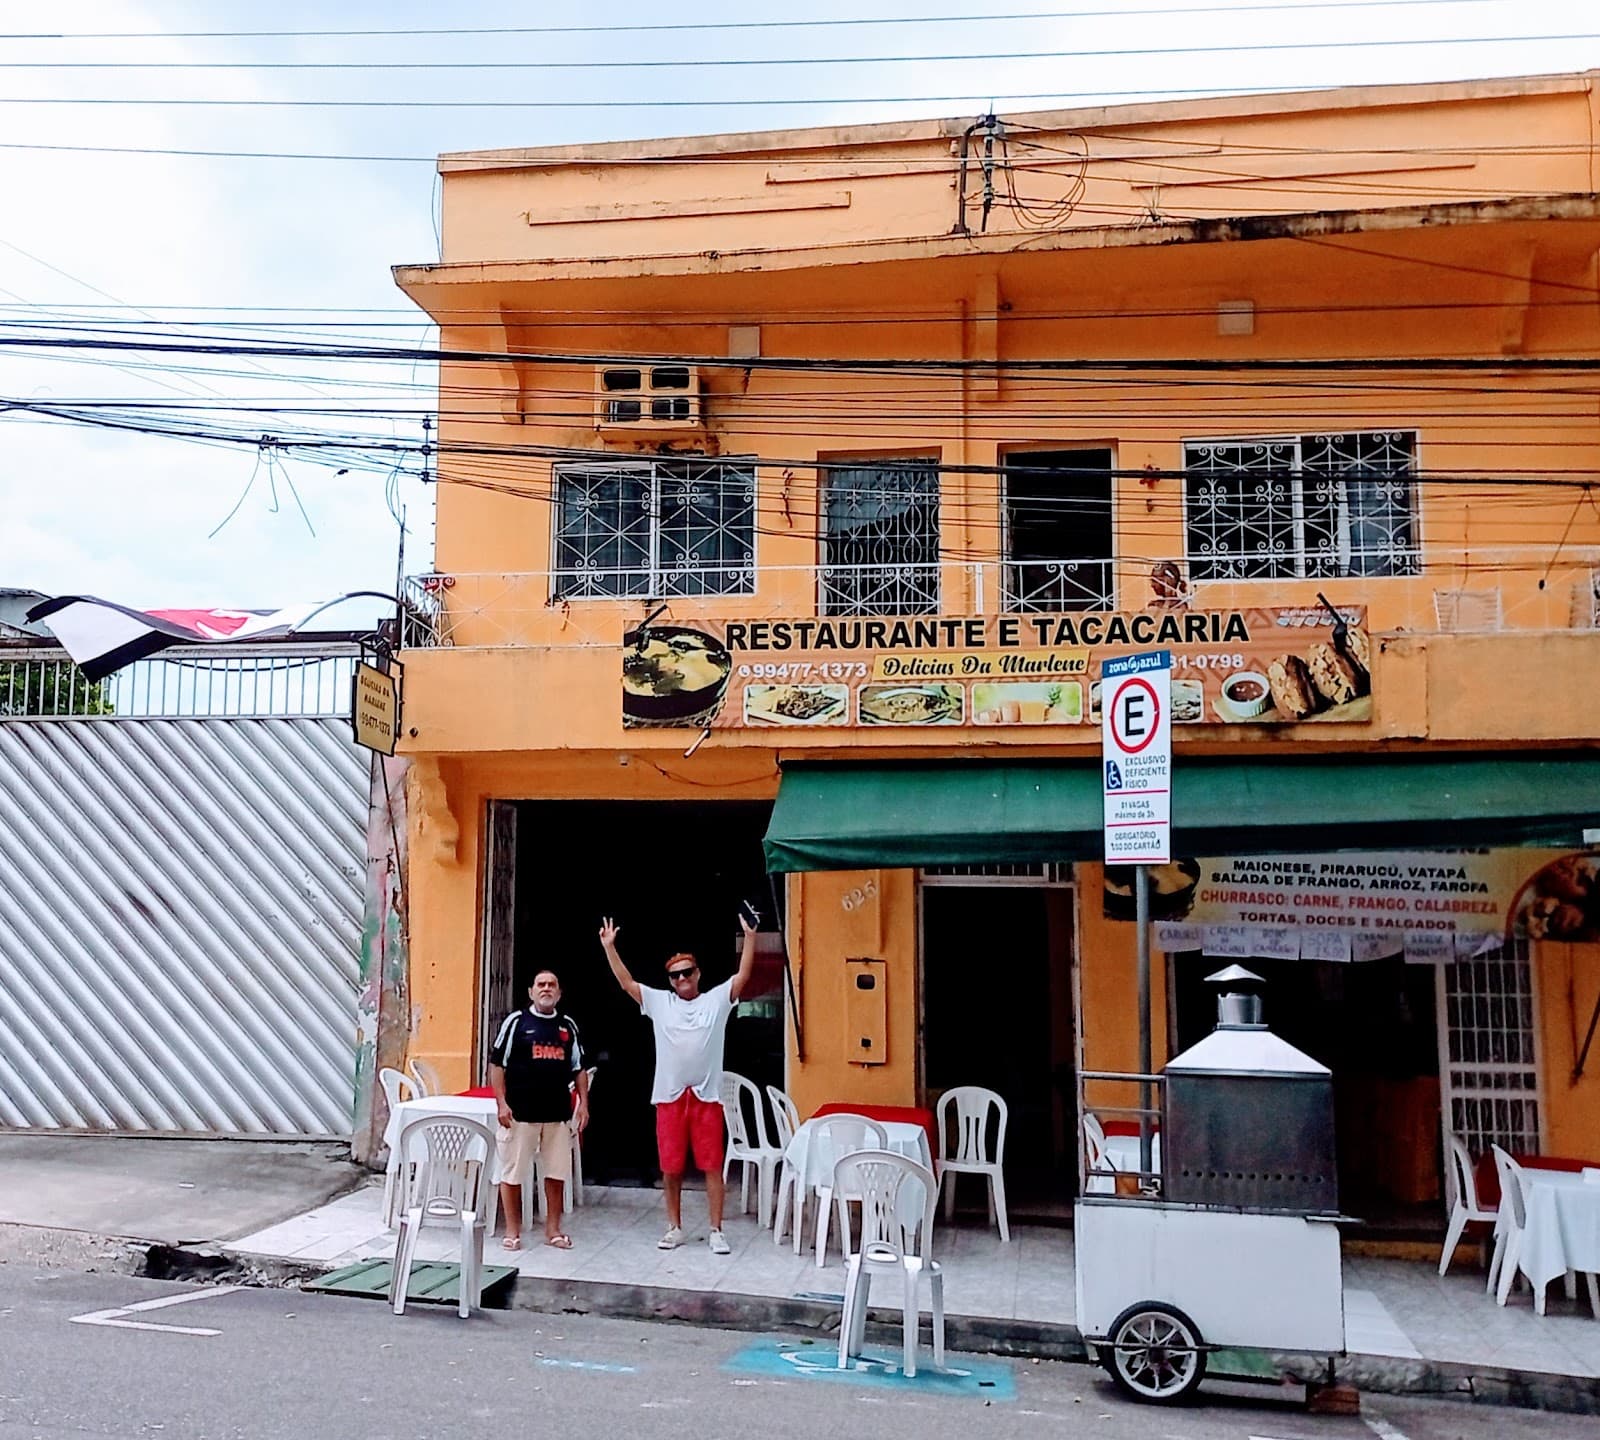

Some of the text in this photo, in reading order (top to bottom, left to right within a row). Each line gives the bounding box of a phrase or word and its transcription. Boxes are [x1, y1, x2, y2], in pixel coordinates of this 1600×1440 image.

[725, 613, 1250, 651] RESTAURANTE E TACACARIA
[999, 654, 1085, 673] Marlene
[1140, 652, 1162, 668] azul
[751, 663, 867, 679] 99477-1373
[1125, 695, 1145, 737] E
[1125, 754, 1167, 767] EXCLUSIVO
[1125, 766, 1167, 778] DEFICIENTE
[1233, 861, 1316, 875] MAIONESE,
[1211, 872, 1489, 893] SALADA DE FRANGO, ARROZ, FAROFA
[841, 880, 878, 912] 625
[1348, 896, 1410, 912] FRANGO,
[1415, 899, 1498, 915] CALABREZA
[1306, 914, 1356, 927] DOCES
[1361, 917, 1370, 927] E
[1375, 917, 1457, 931] SALGADOS
